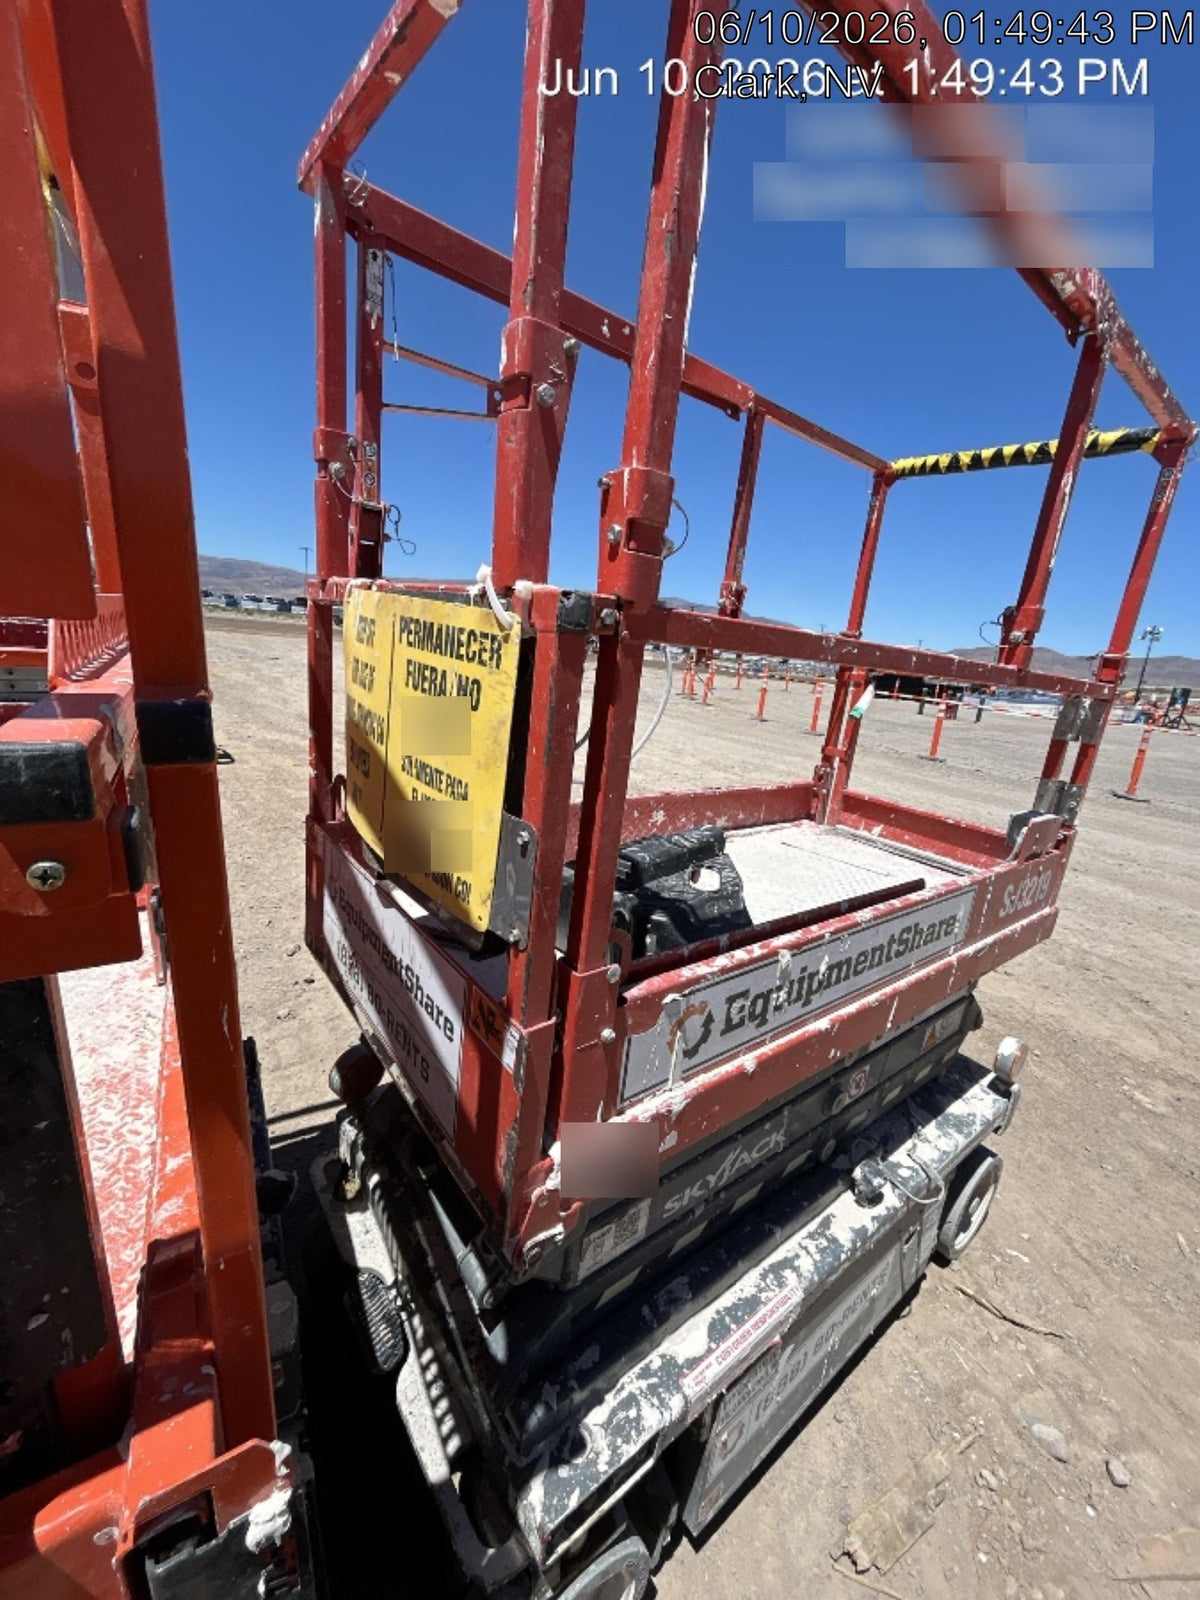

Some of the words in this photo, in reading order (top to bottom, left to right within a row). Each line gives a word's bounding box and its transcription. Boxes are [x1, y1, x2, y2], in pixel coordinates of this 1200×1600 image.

[399, 615, 502, 671] PERMANECER
[405, 658, 447, 697] FUERA
[338, 885, 455, 1043] EquipmentShare
[720, 913, 957, 1038] EquipmentShare
[662, 1131, 787, 1219] SKYJACK
